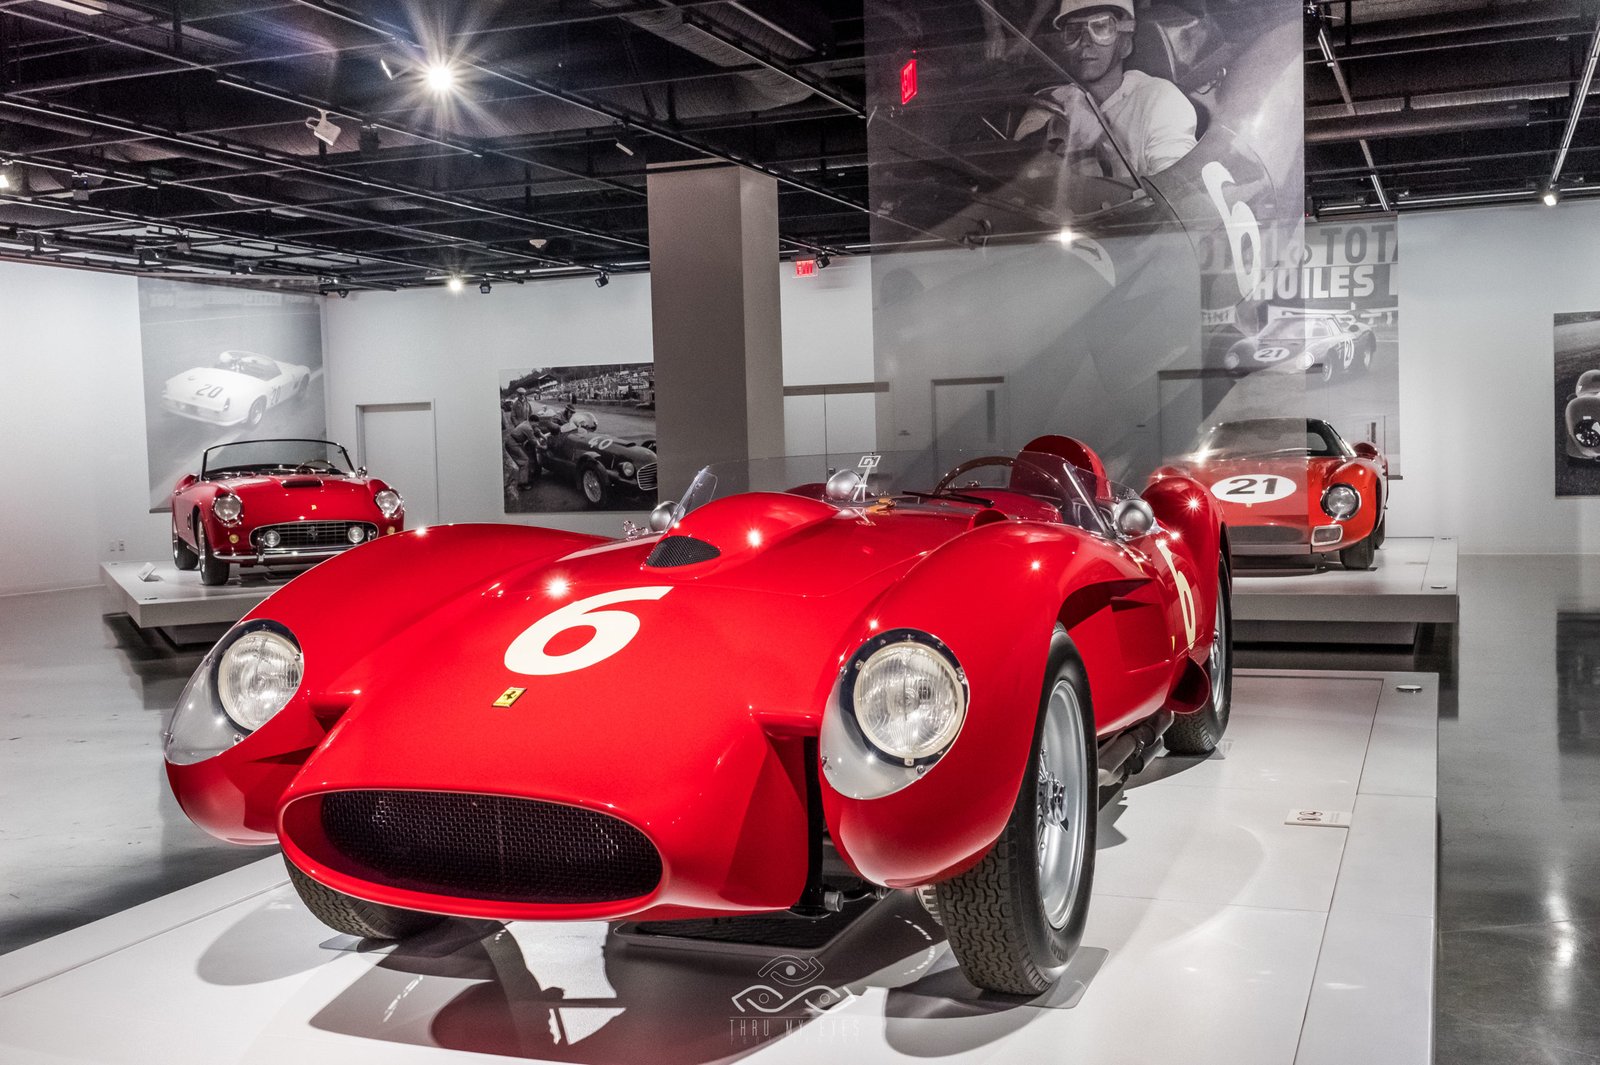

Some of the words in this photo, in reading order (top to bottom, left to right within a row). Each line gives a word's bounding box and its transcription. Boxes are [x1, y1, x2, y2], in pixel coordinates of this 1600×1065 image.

[1202, 161, 1261, 301] 6
[1320, 224, 1398, 268] TOT
[1252, 265, 1375, 301] HUILES
[1258, 348, 1284, 359] 21
[196, 383, 224, 399] 20
[1225, 477, 1279, 495] 21
[503, 586, 675, 676] 6
